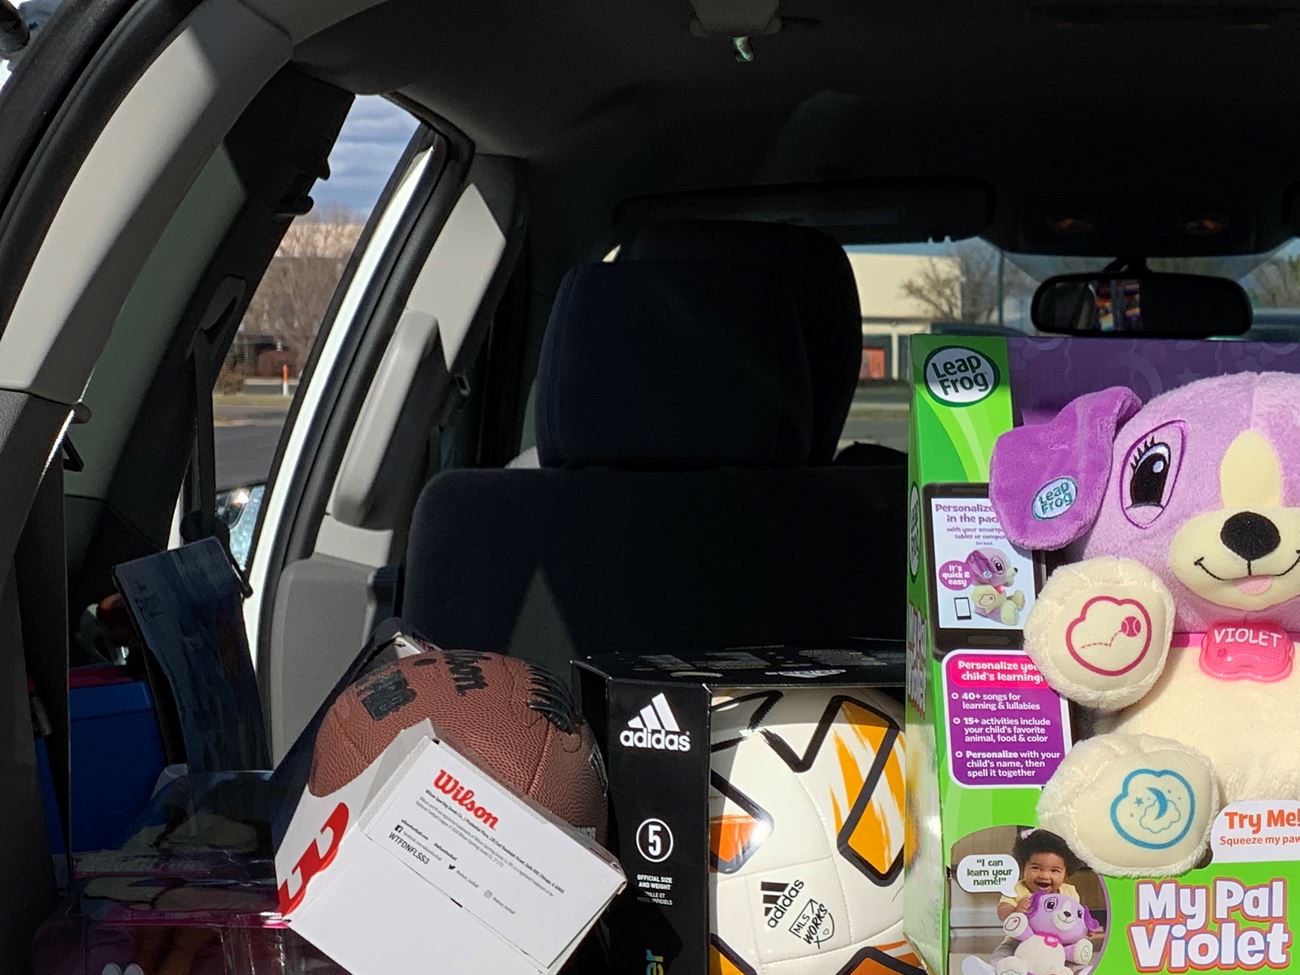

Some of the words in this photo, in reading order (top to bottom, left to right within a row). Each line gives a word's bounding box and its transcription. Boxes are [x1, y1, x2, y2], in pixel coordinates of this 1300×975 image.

[930, 355, 981, 379] Leap
[938, 371, 990, 396] Frog
[1038, 482, 1069, 504] Leap
[1040, 492, 1072, 514] Frog
[1213, 627, 1282, 649] VIOLET
[958, 660, 1018, 671] Personalize
[961, 670, 995, 681] child's
[961, 692, 981, 700] 40+
[982, 693, 1008, 701] songs
[962, 701, 997, 710] learning
[1006, 702, 1040, 710] lullabies
[619, 729, 691, 751] adidas
[966, 750, 1018, 758] Personalize
[1040, 752, 1060, 760] your
[433, 768, 500, 830] Wilson
[1224, 811, 1262, 834] Try
[648, 824, 662, 857] 5
[1220, 835, 1263, 847] Squeeze
[1265, 837, 1280, 847] my
[966, 868, 989, 876] learn
[992, 869, 1013, 879] your
[987, 859, 1003, 867] can
[767, 879, 804, 928] adidas
[1137, 881, 1209, 931] My
[1214, 879, 1285, 920] Pal
[793, 913, 811, 934] MLS
[802, 903, 828, 945] WORKS
[1129, 921, 1290, 969] Violet
